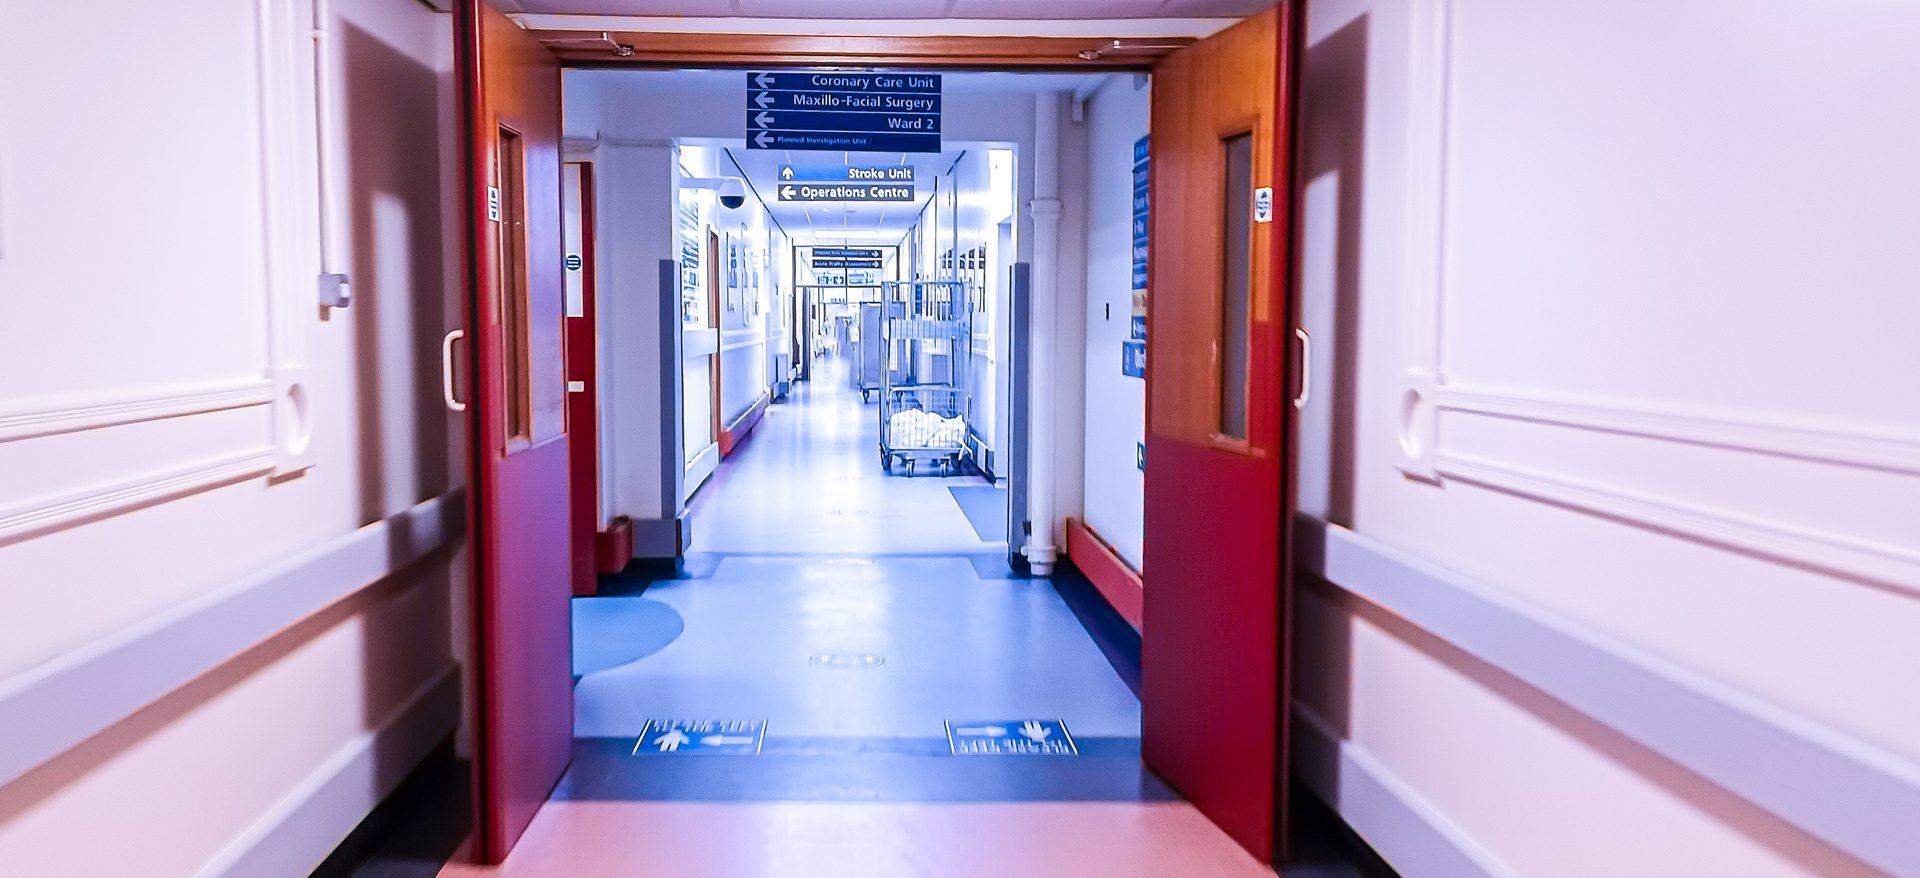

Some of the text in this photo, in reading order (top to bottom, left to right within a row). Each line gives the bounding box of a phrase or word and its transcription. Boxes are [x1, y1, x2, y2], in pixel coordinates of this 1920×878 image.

[812, 75, 934, 90] Coronary Care Unit
[793, 94, 934, 111] Maxillo-Facial Surgery
[888, 117, 934, 130] Ward 2
[777, 136, 805, 144] Planned
[807, 137, 850, 145] Investigation
[852, 137, 867, 145] Unit
[848, 167, 912, 180] Stroke Unit
[801, 185, 909, 200] Operations Centre
